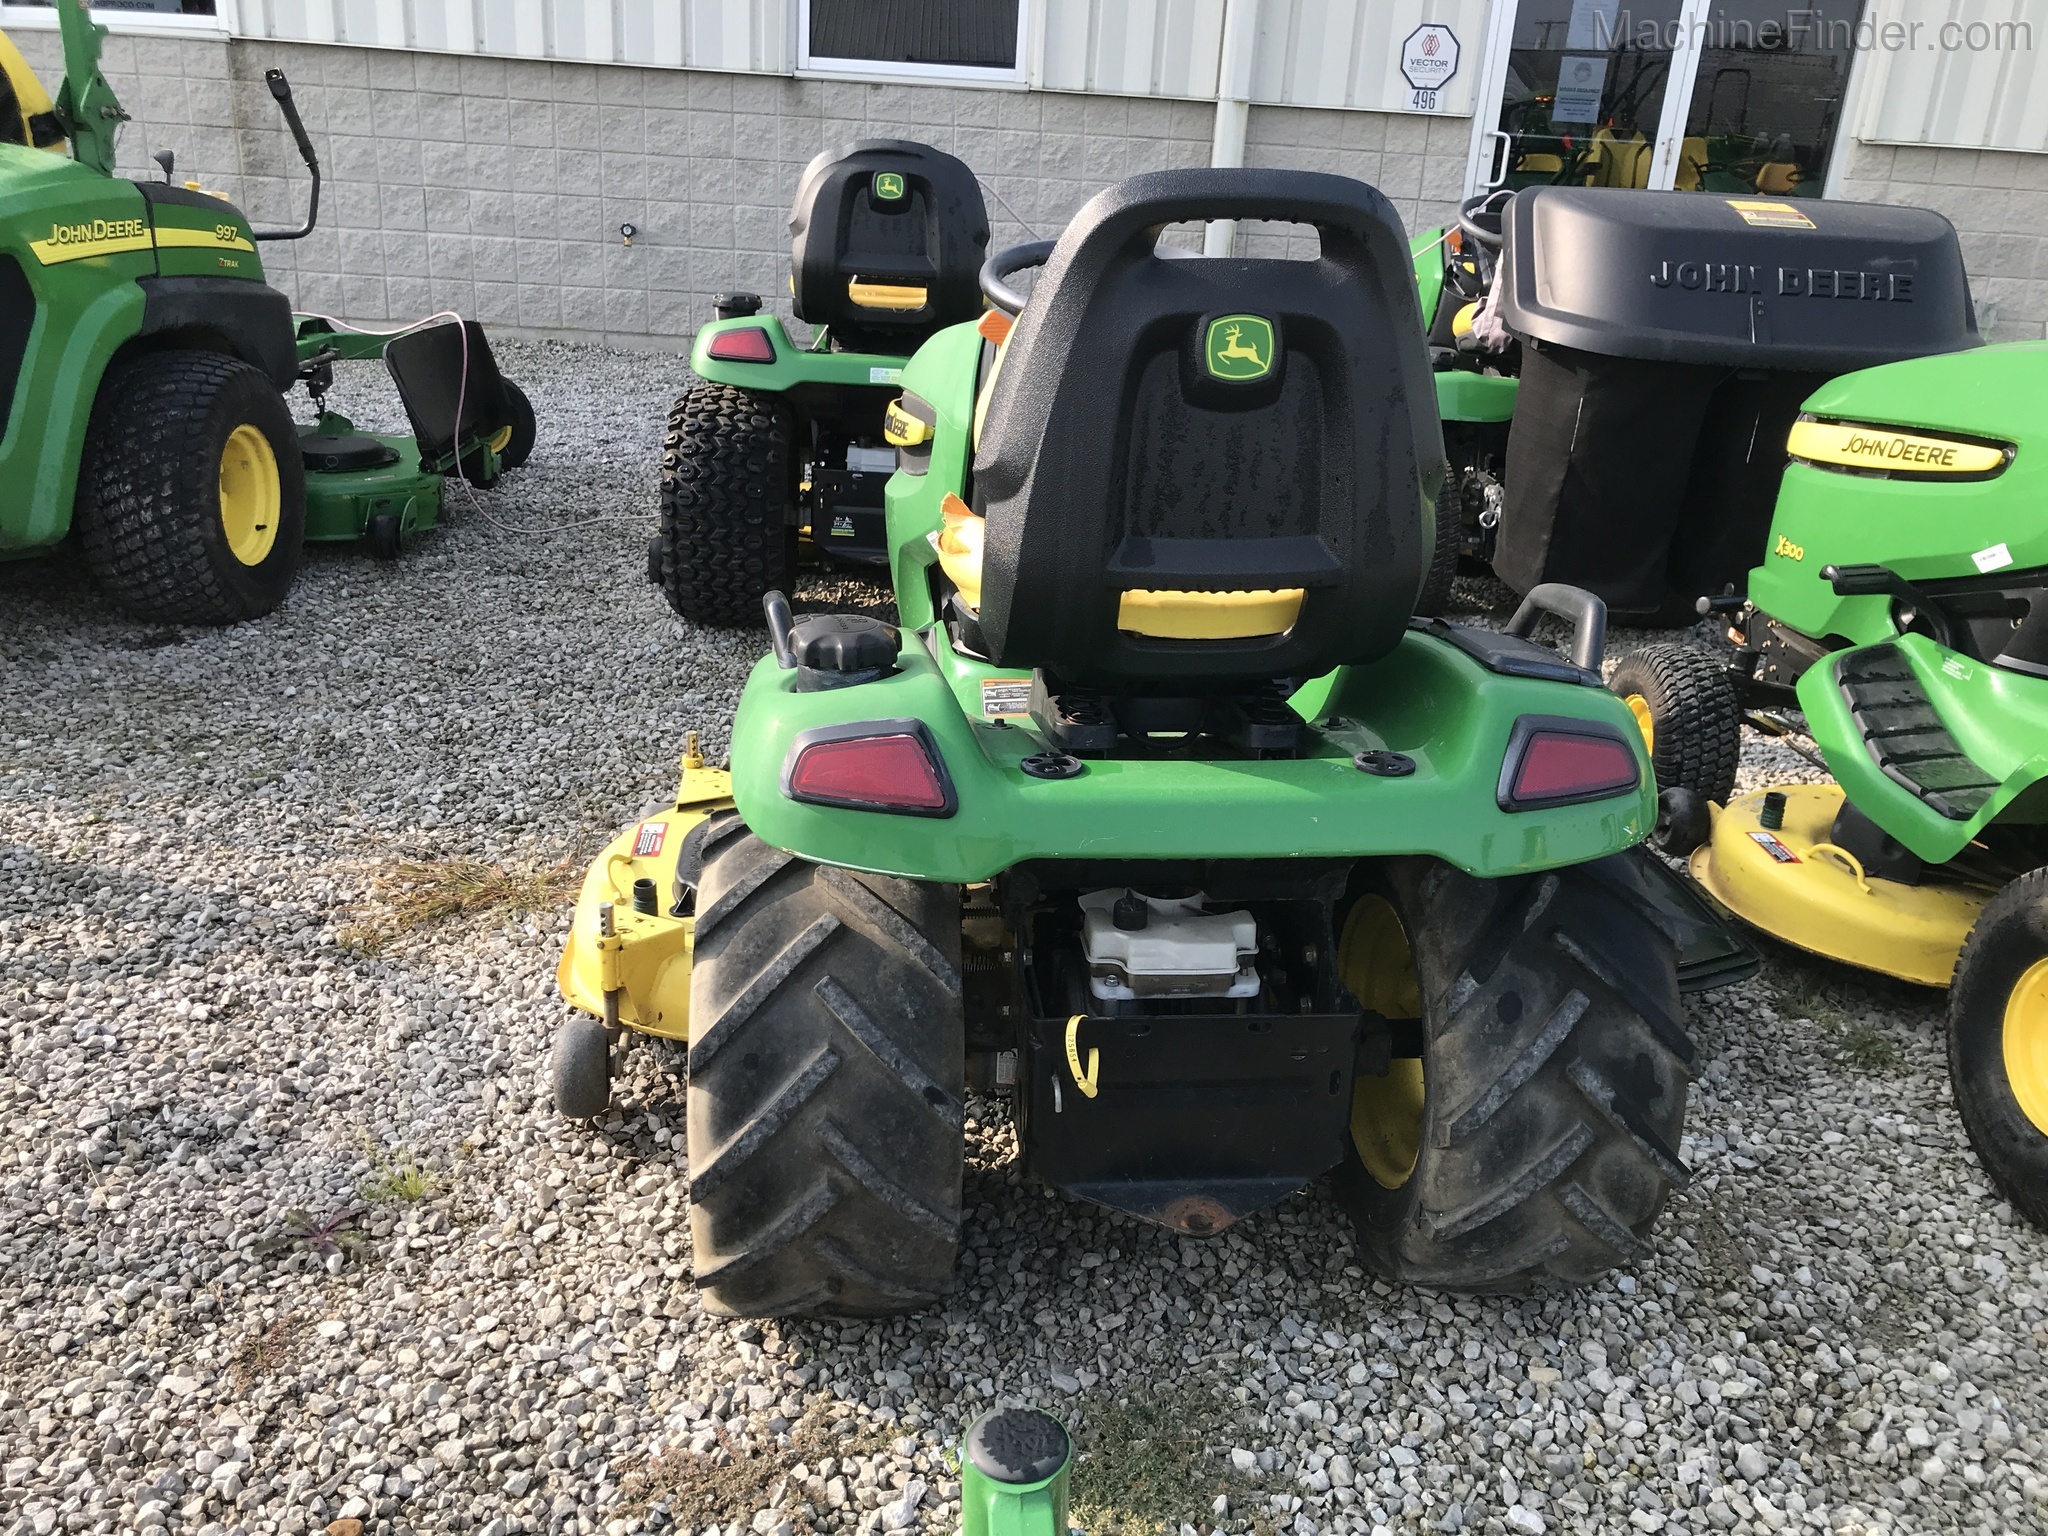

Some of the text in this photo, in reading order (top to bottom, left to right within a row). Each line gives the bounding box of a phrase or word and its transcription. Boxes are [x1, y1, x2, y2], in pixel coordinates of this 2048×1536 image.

[1410, 58, 1448, 67] VECTOR
[1413, 91, 1436, 109] 496
[47, 219, 144, 246] JOHN DEERE
[215, 224, 238, 242] 997
[1650, 261, 1914, 302] JOHN DEERE
[1841, 433, 1958, 467] JOHN DEERE
[1775, 534, 1804, 561] X300
